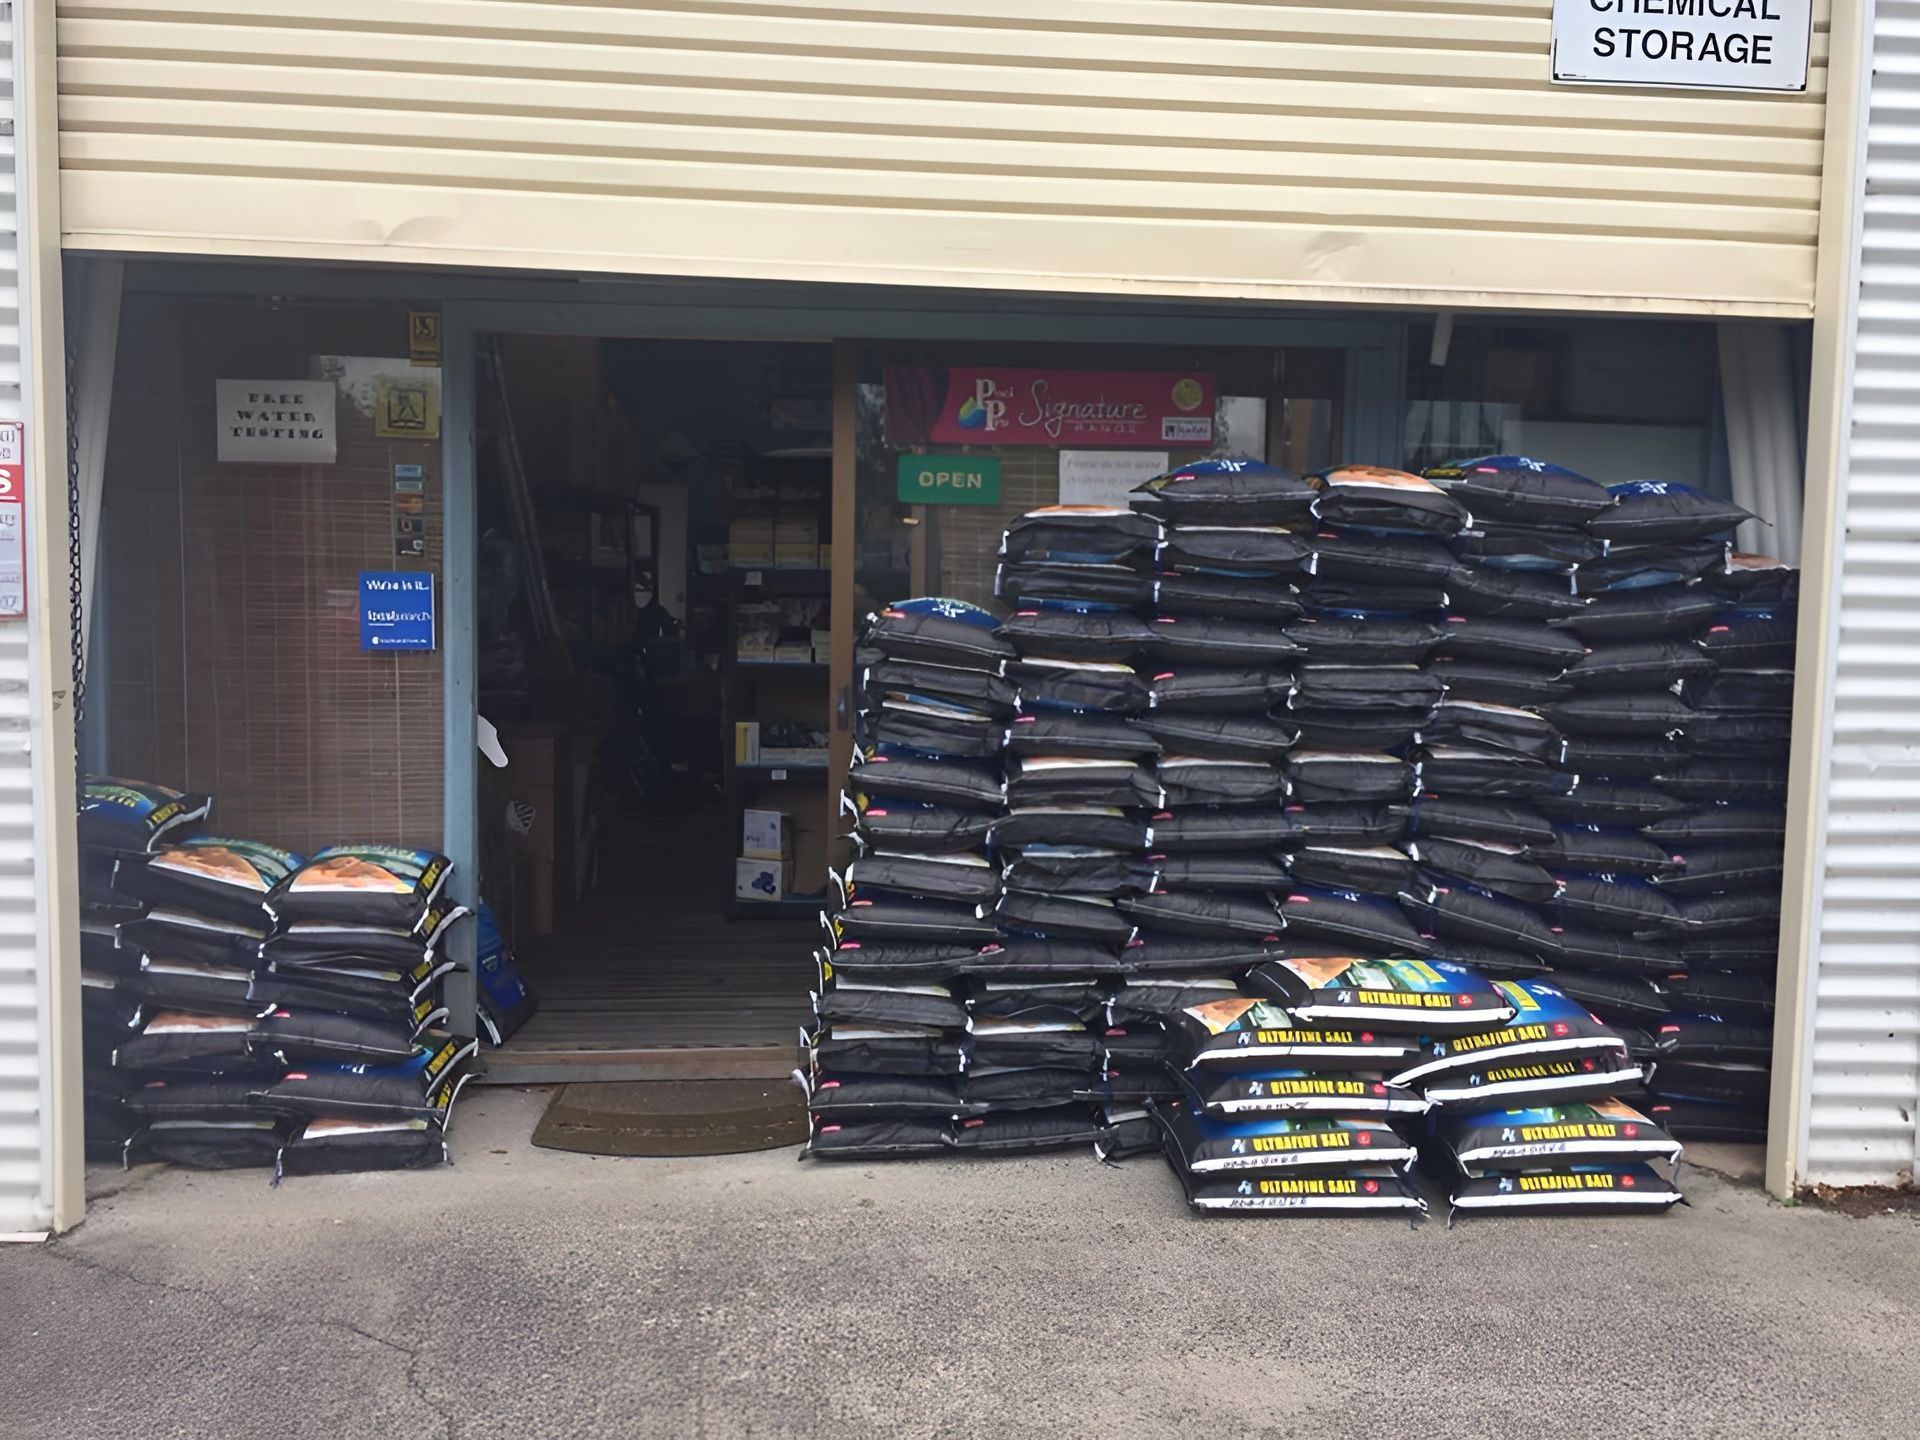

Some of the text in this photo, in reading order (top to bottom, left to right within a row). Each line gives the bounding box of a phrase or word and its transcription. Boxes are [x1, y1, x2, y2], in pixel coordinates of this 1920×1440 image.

[1593, 27, 1773, 64] STORAGE
[248, 393, 304, 404] FREE
[234, 410, 316, 422] WATER
[1018, 379, 1147, 438] Signature
[229, 426, 323, 439] TESTING
[918, 471, 982, 489] OPEN
